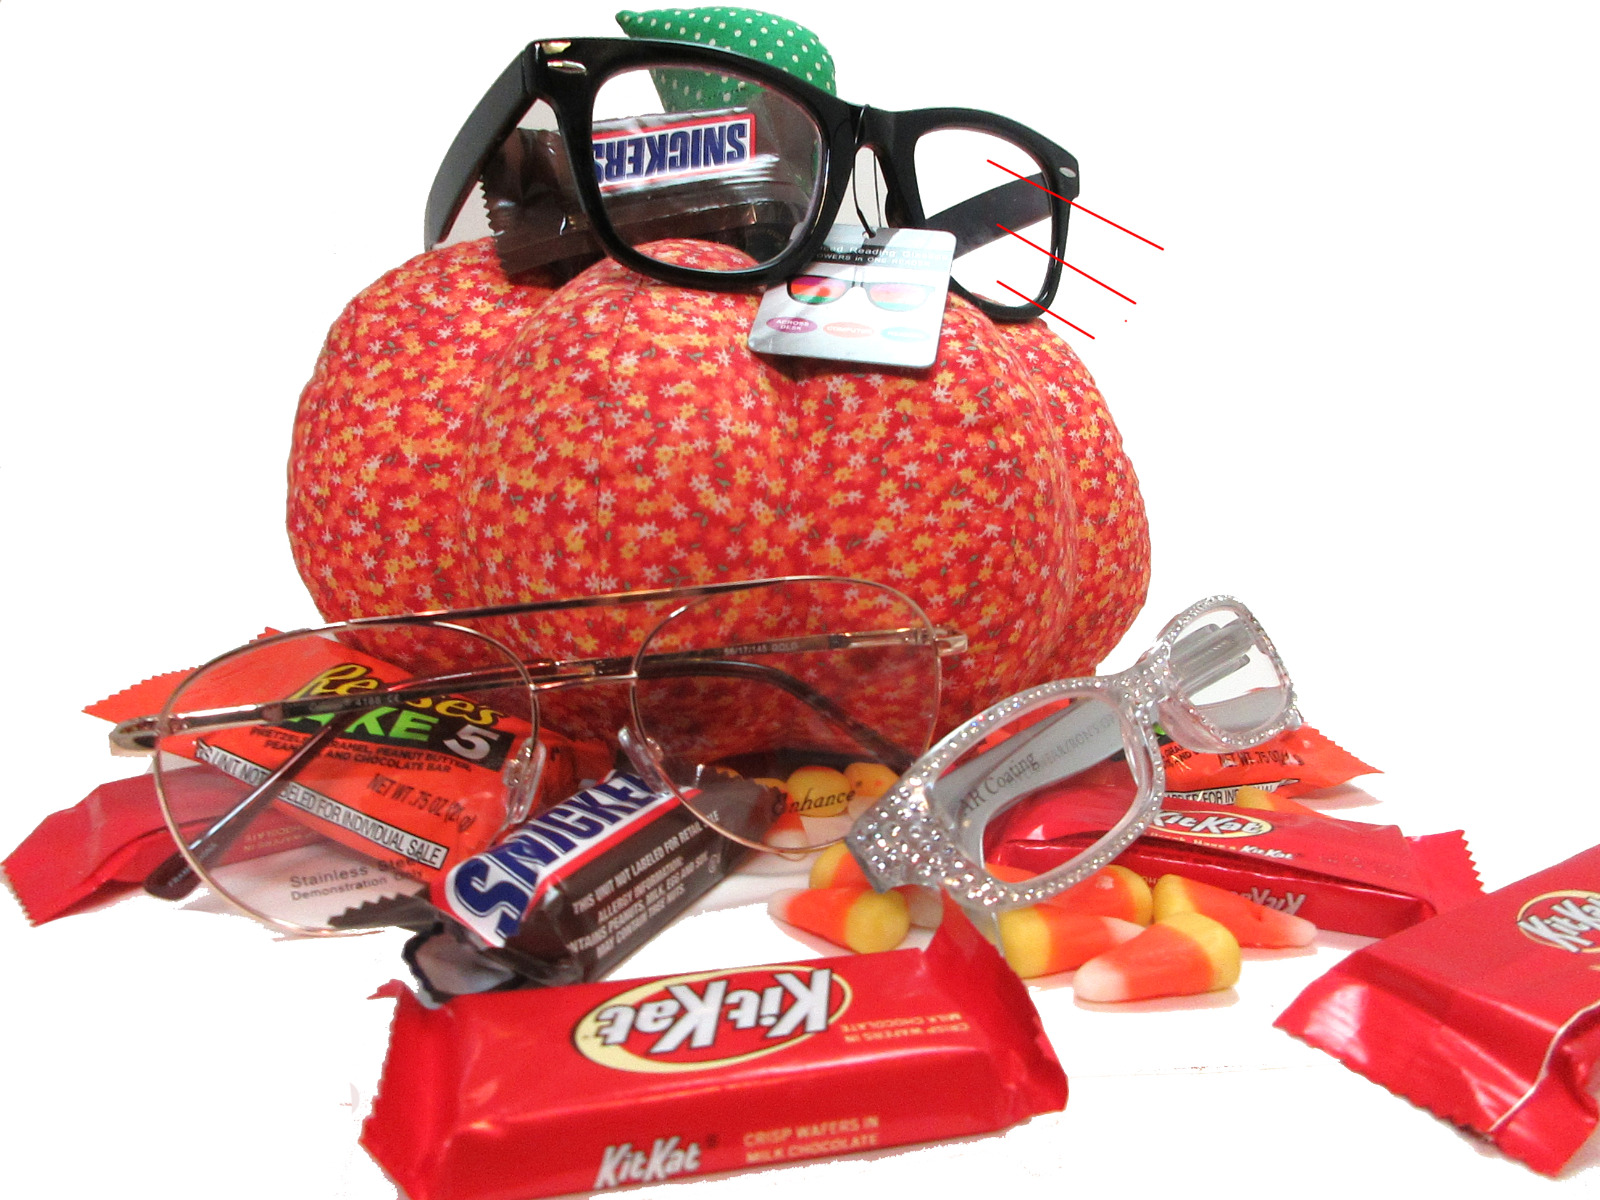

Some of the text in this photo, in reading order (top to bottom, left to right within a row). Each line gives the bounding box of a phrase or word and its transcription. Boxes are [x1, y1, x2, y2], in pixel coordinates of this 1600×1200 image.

[589, 123, 748, 185] SNICKERS
[816, 252, 851, 261] OWERS
[867, 256, 888, 264] ONE
[850, 246, 896, 258] Reading
[776, 319, 810, 327] ACROSS
[444, 724, 500, 760] 5
[367, 773, 397, 797] NET
[961, 752, 1041, 816] AR Coating
[772, 787, 857, 815] Enhance
[316, 799, 342, 822] FOR
[341, 810, 405, 852] INDIVIDUAL
[406, 840, 442, 866] SALE
[1152, 811, 1264, 835] KitKat
[614, 867, 633, 888] NOT
[631, 846, 665, 877] LABELED
[663, 837, 681, 854] FOR
[1241, 844, 1295, 860] KitKat
[290, 866, 369, 888] Stainless
[291, 876, 388, 901] Demonstration
[596, 968, 833, 1054] KitKat
[841, 1012, 962, 1033] MILK CHOCOLATE
[844, 1021, 970, 1043] CRISP WAFERS IN
[743, 1115, 879, 1147] CRISP WAFERS IN
[746, 1134, 877, 1163] MILK CHOCOLATE
[594, 1136, 702, 1189] KitKat
